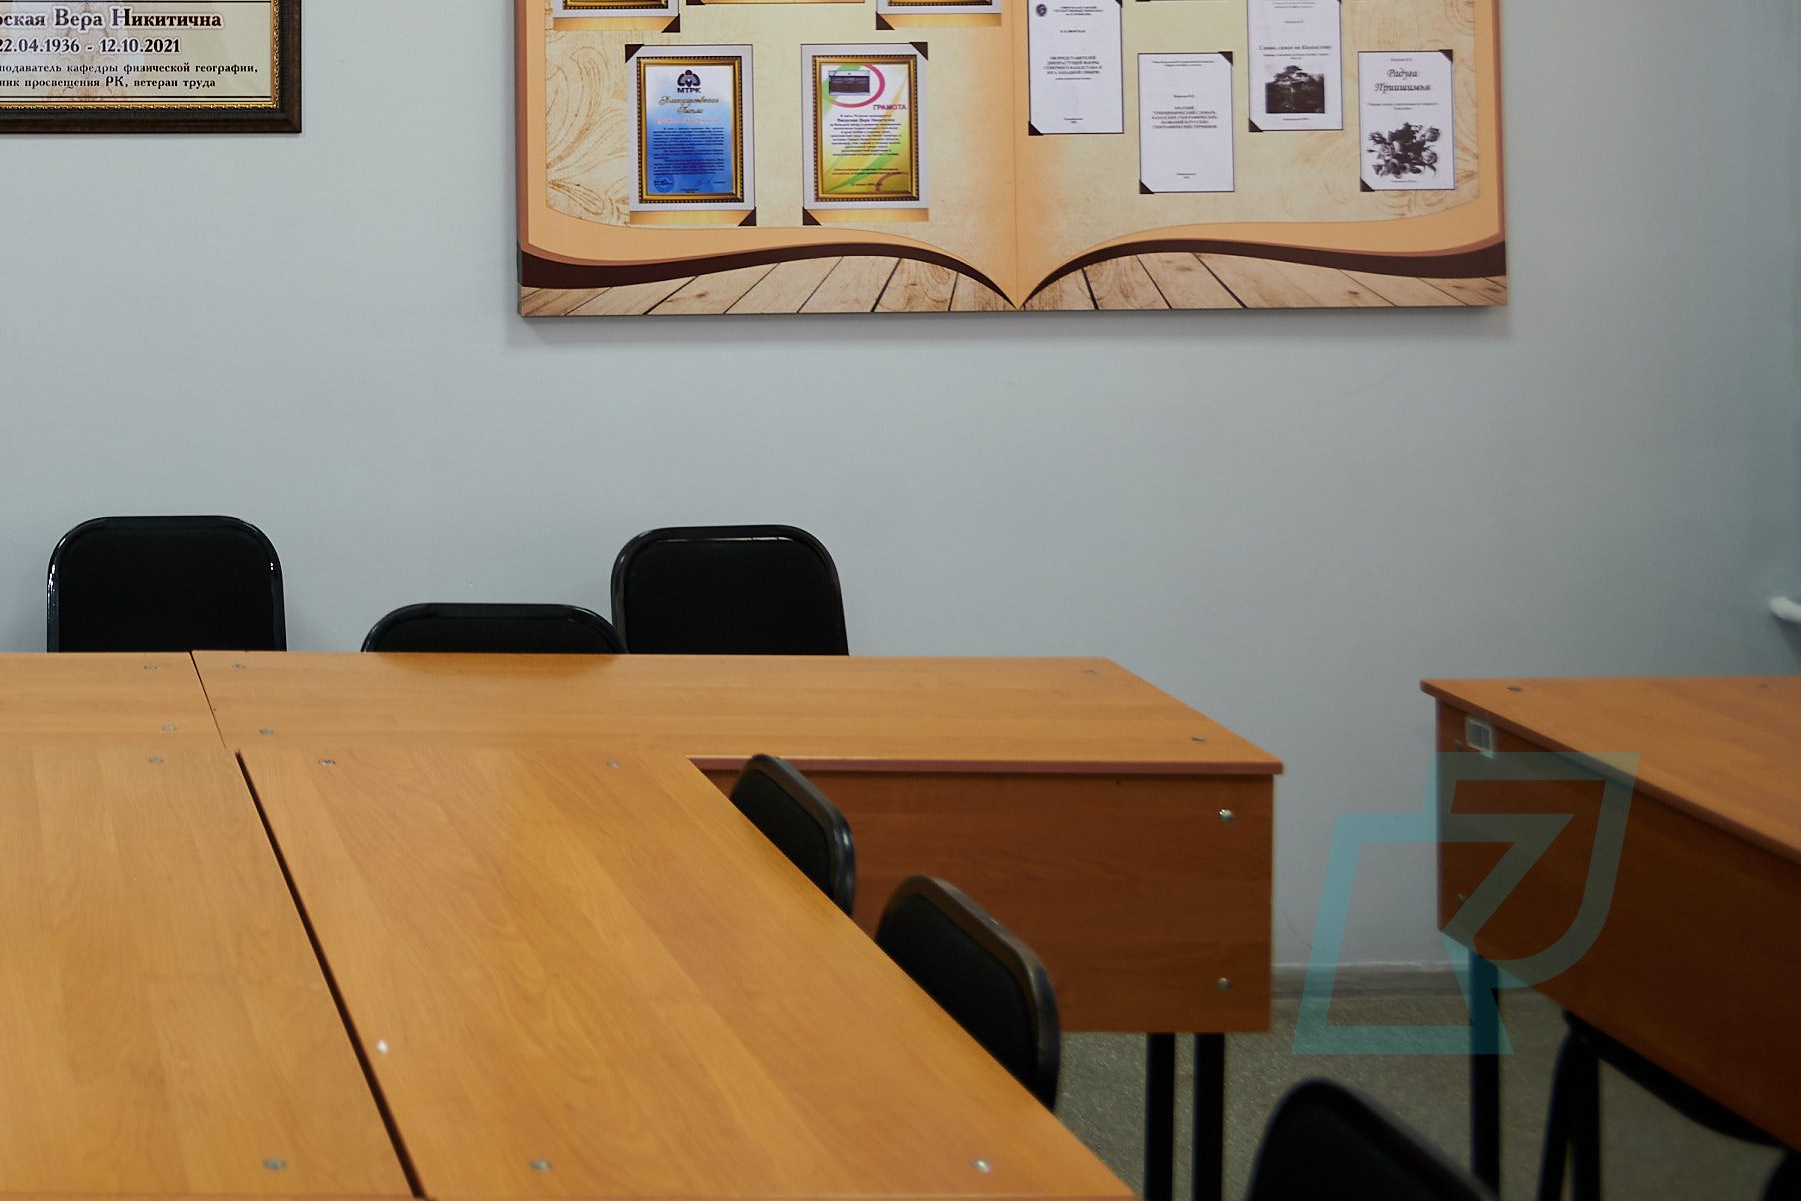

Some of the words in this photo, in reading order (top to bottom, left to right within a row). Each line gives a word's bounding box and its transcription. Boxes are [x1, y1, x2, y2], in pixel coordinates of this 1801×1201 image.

[55, 8, 103, 31] Вера
[111, 8, 222, 28] Никитична
[99, 38, 181, 53] 12.10.2021
[66, 63, 119, 75] кафедры
[123, 62, 191, 75] физической
[195, 63, 259, 75] географии,
[1386, 67, 1418, 80] Радуга
[24, 78, 101, 90] просвещения
[105, 75, 129, 89] РК,
[133, 78, 179, 89] ветеран
[183, 78, 217, 90] труда
